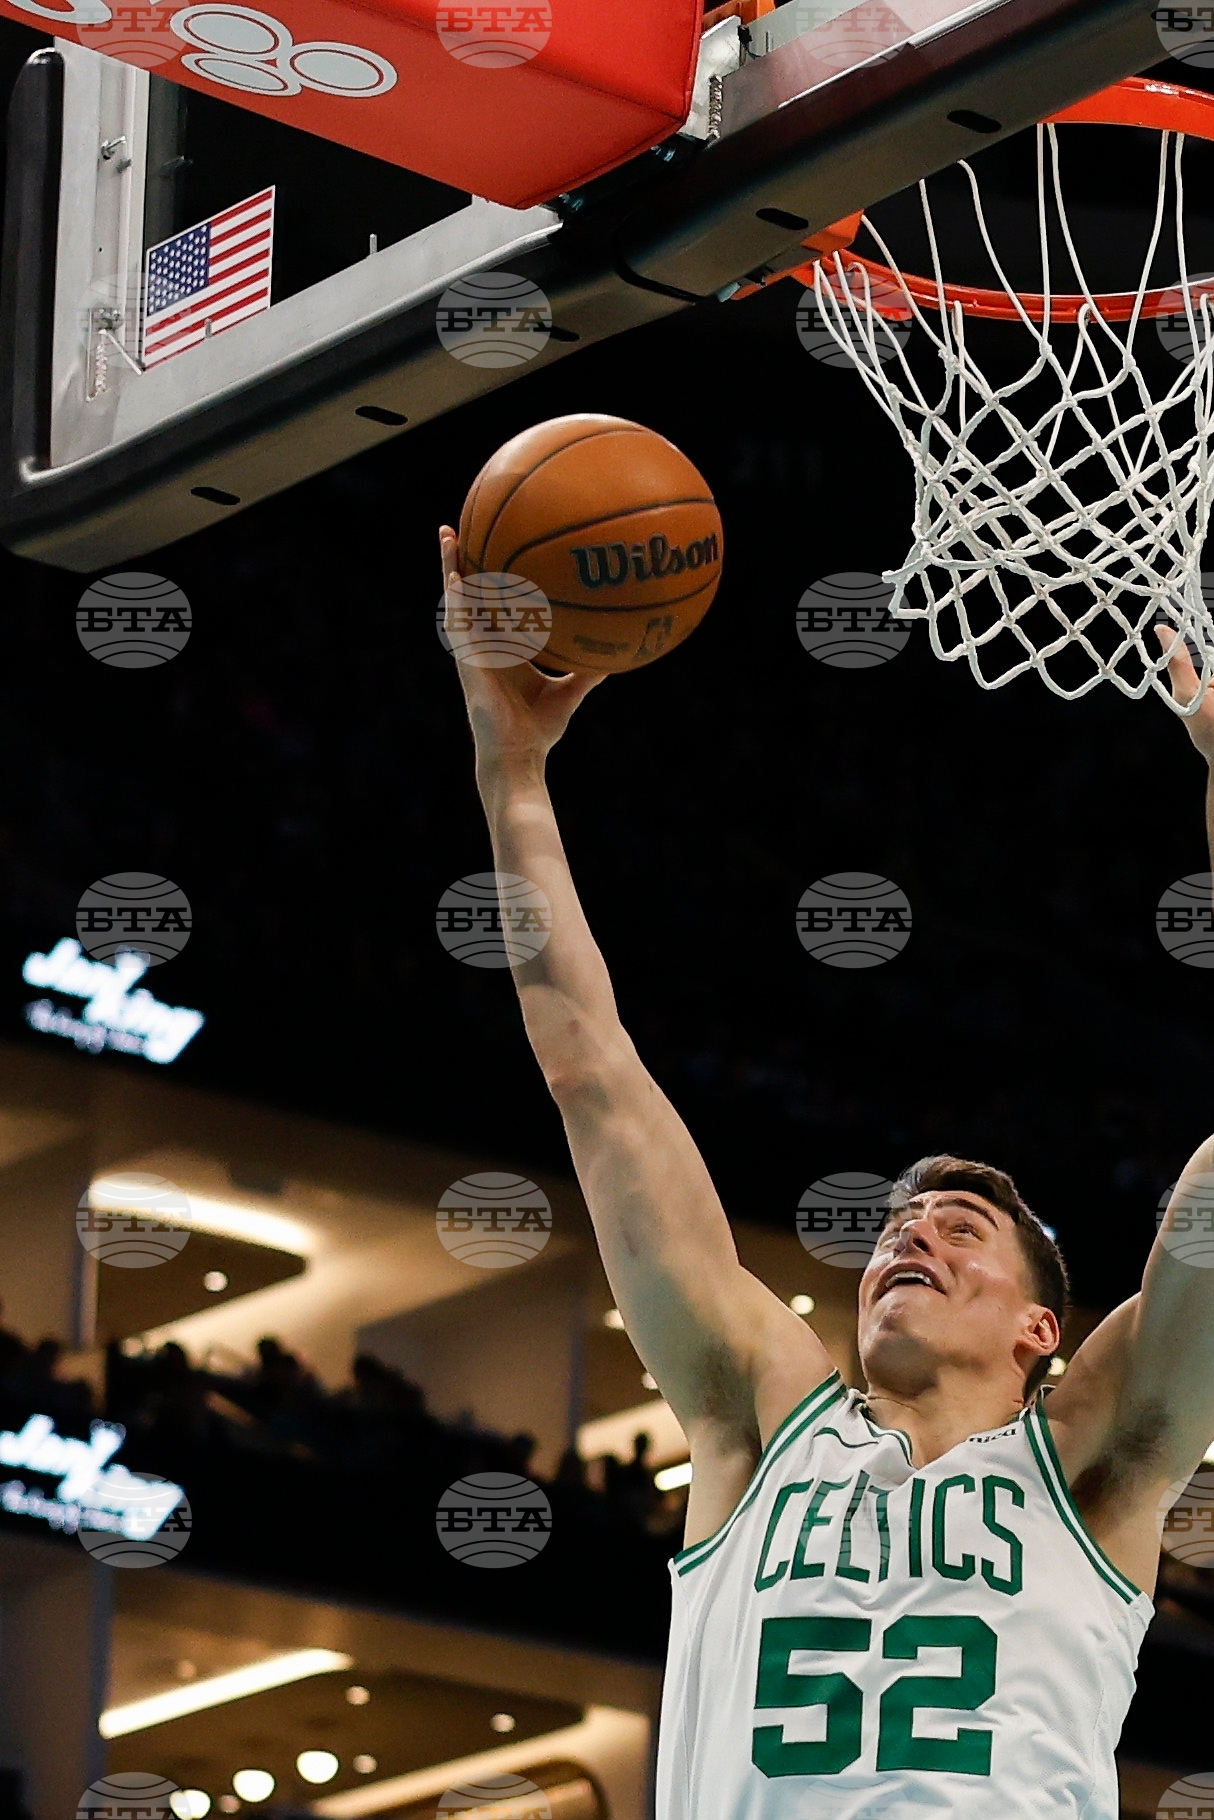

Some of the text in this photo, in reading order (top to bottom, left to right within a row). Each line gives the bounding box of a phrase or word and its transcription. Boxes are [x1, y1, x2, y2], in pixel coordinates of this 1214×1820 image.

[570, 532, 719, 590] Wilson
[753, 1470, 1025, 1597] CELTICS
[752, 1614, 998, 1778] 52
